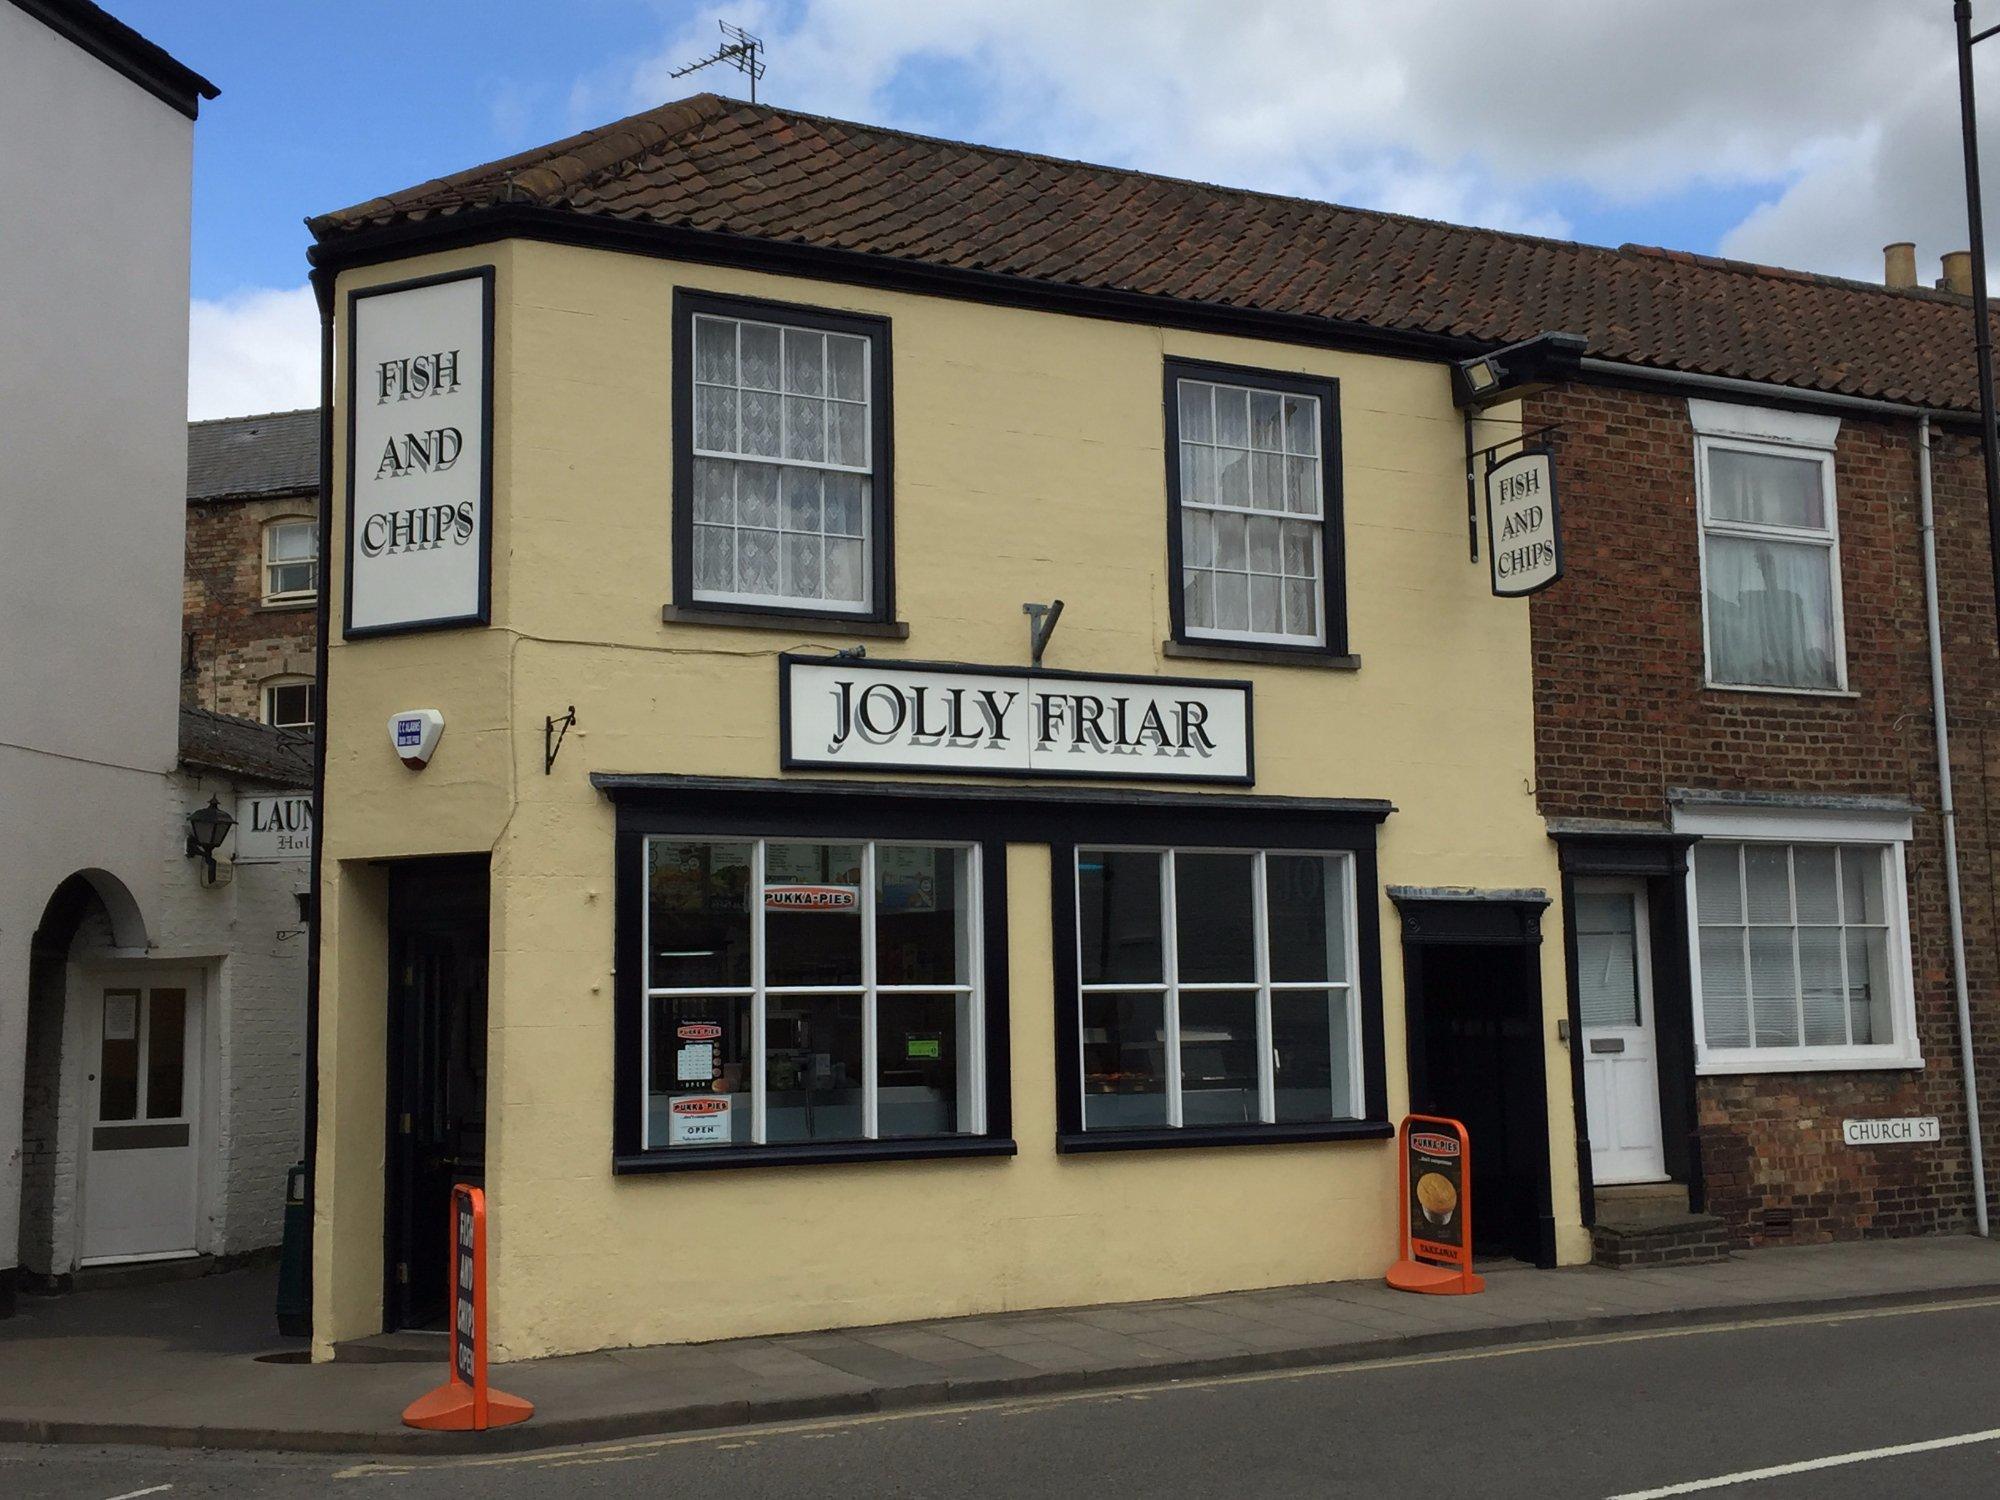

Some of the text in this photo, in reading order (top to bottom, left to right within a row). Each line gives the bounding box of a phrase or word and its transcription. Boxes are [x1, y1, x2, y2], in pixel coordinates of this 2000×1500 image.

[377, 350, 461, 405] FISH
[375, 427, 463, 480] AND
[1499, 468, 1540, 505] FISH
[361, 501, 474, 558] CHIPS
[1501, 505, 1543, 541] AND
[1497, 539, 1554, 578] CHIPS
[828, 681, 1217, 759] JOLLY FRIAR
[687, 1126, 714, 1135] OPEN
[1849, 1122, 1934, 1140] CHURCH ST
